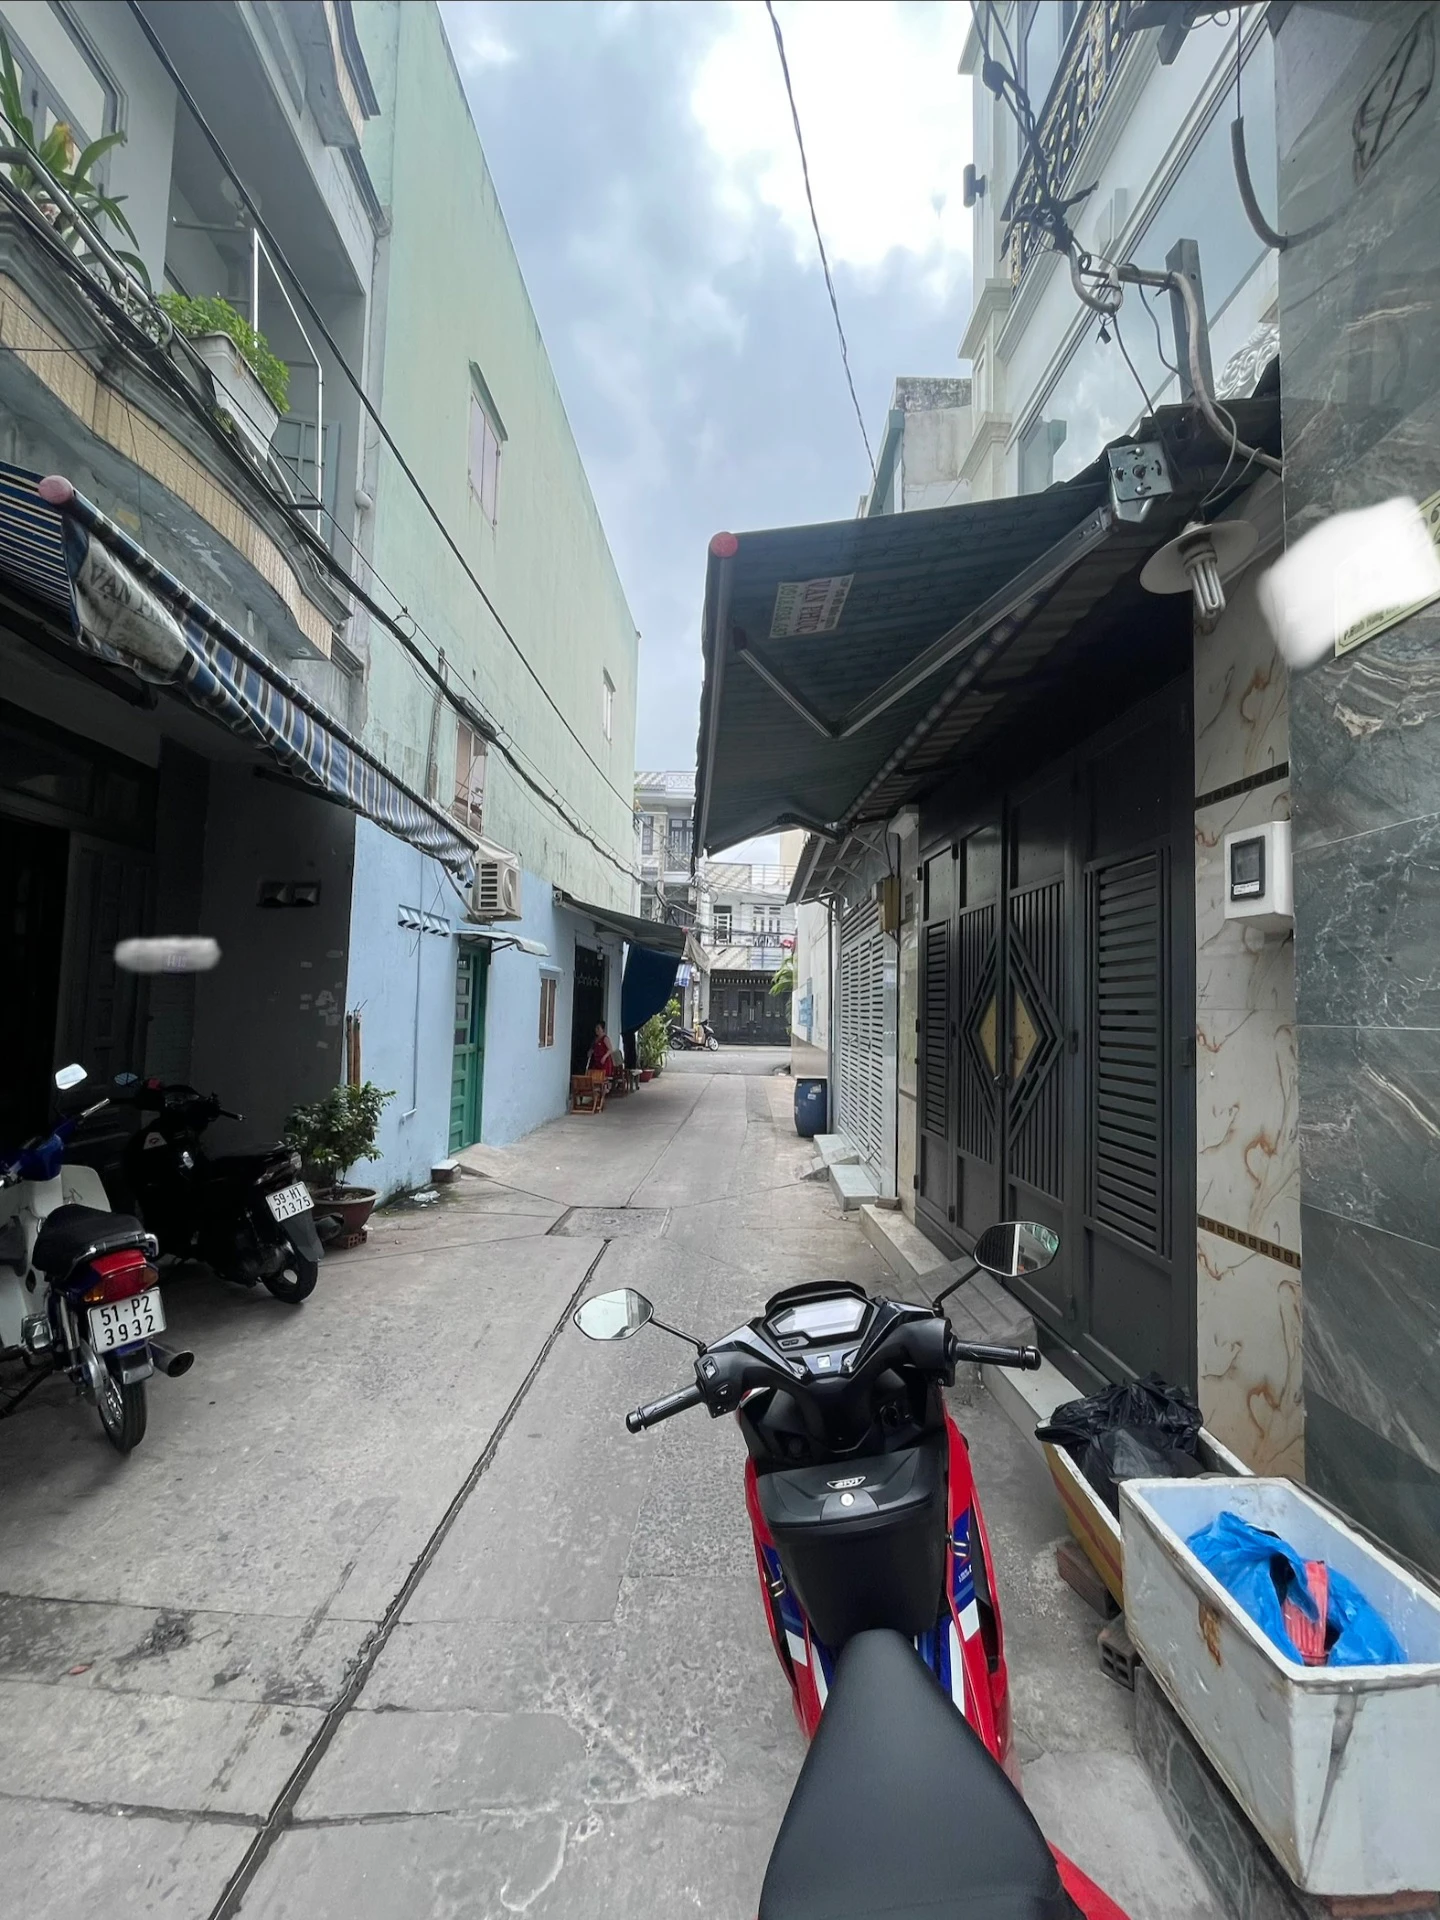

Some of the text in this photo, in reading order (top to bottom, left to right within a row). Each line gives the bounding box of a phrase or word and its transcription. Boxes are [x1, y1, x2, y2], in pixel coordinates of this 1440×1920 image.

[273, 1187, 302, 1206] 59-H1
[275, 1196, 311, 1220] 713.75
[100, 1295, 152, 1326] 51-P2
[104, 1314, 156, 1346] 3932
